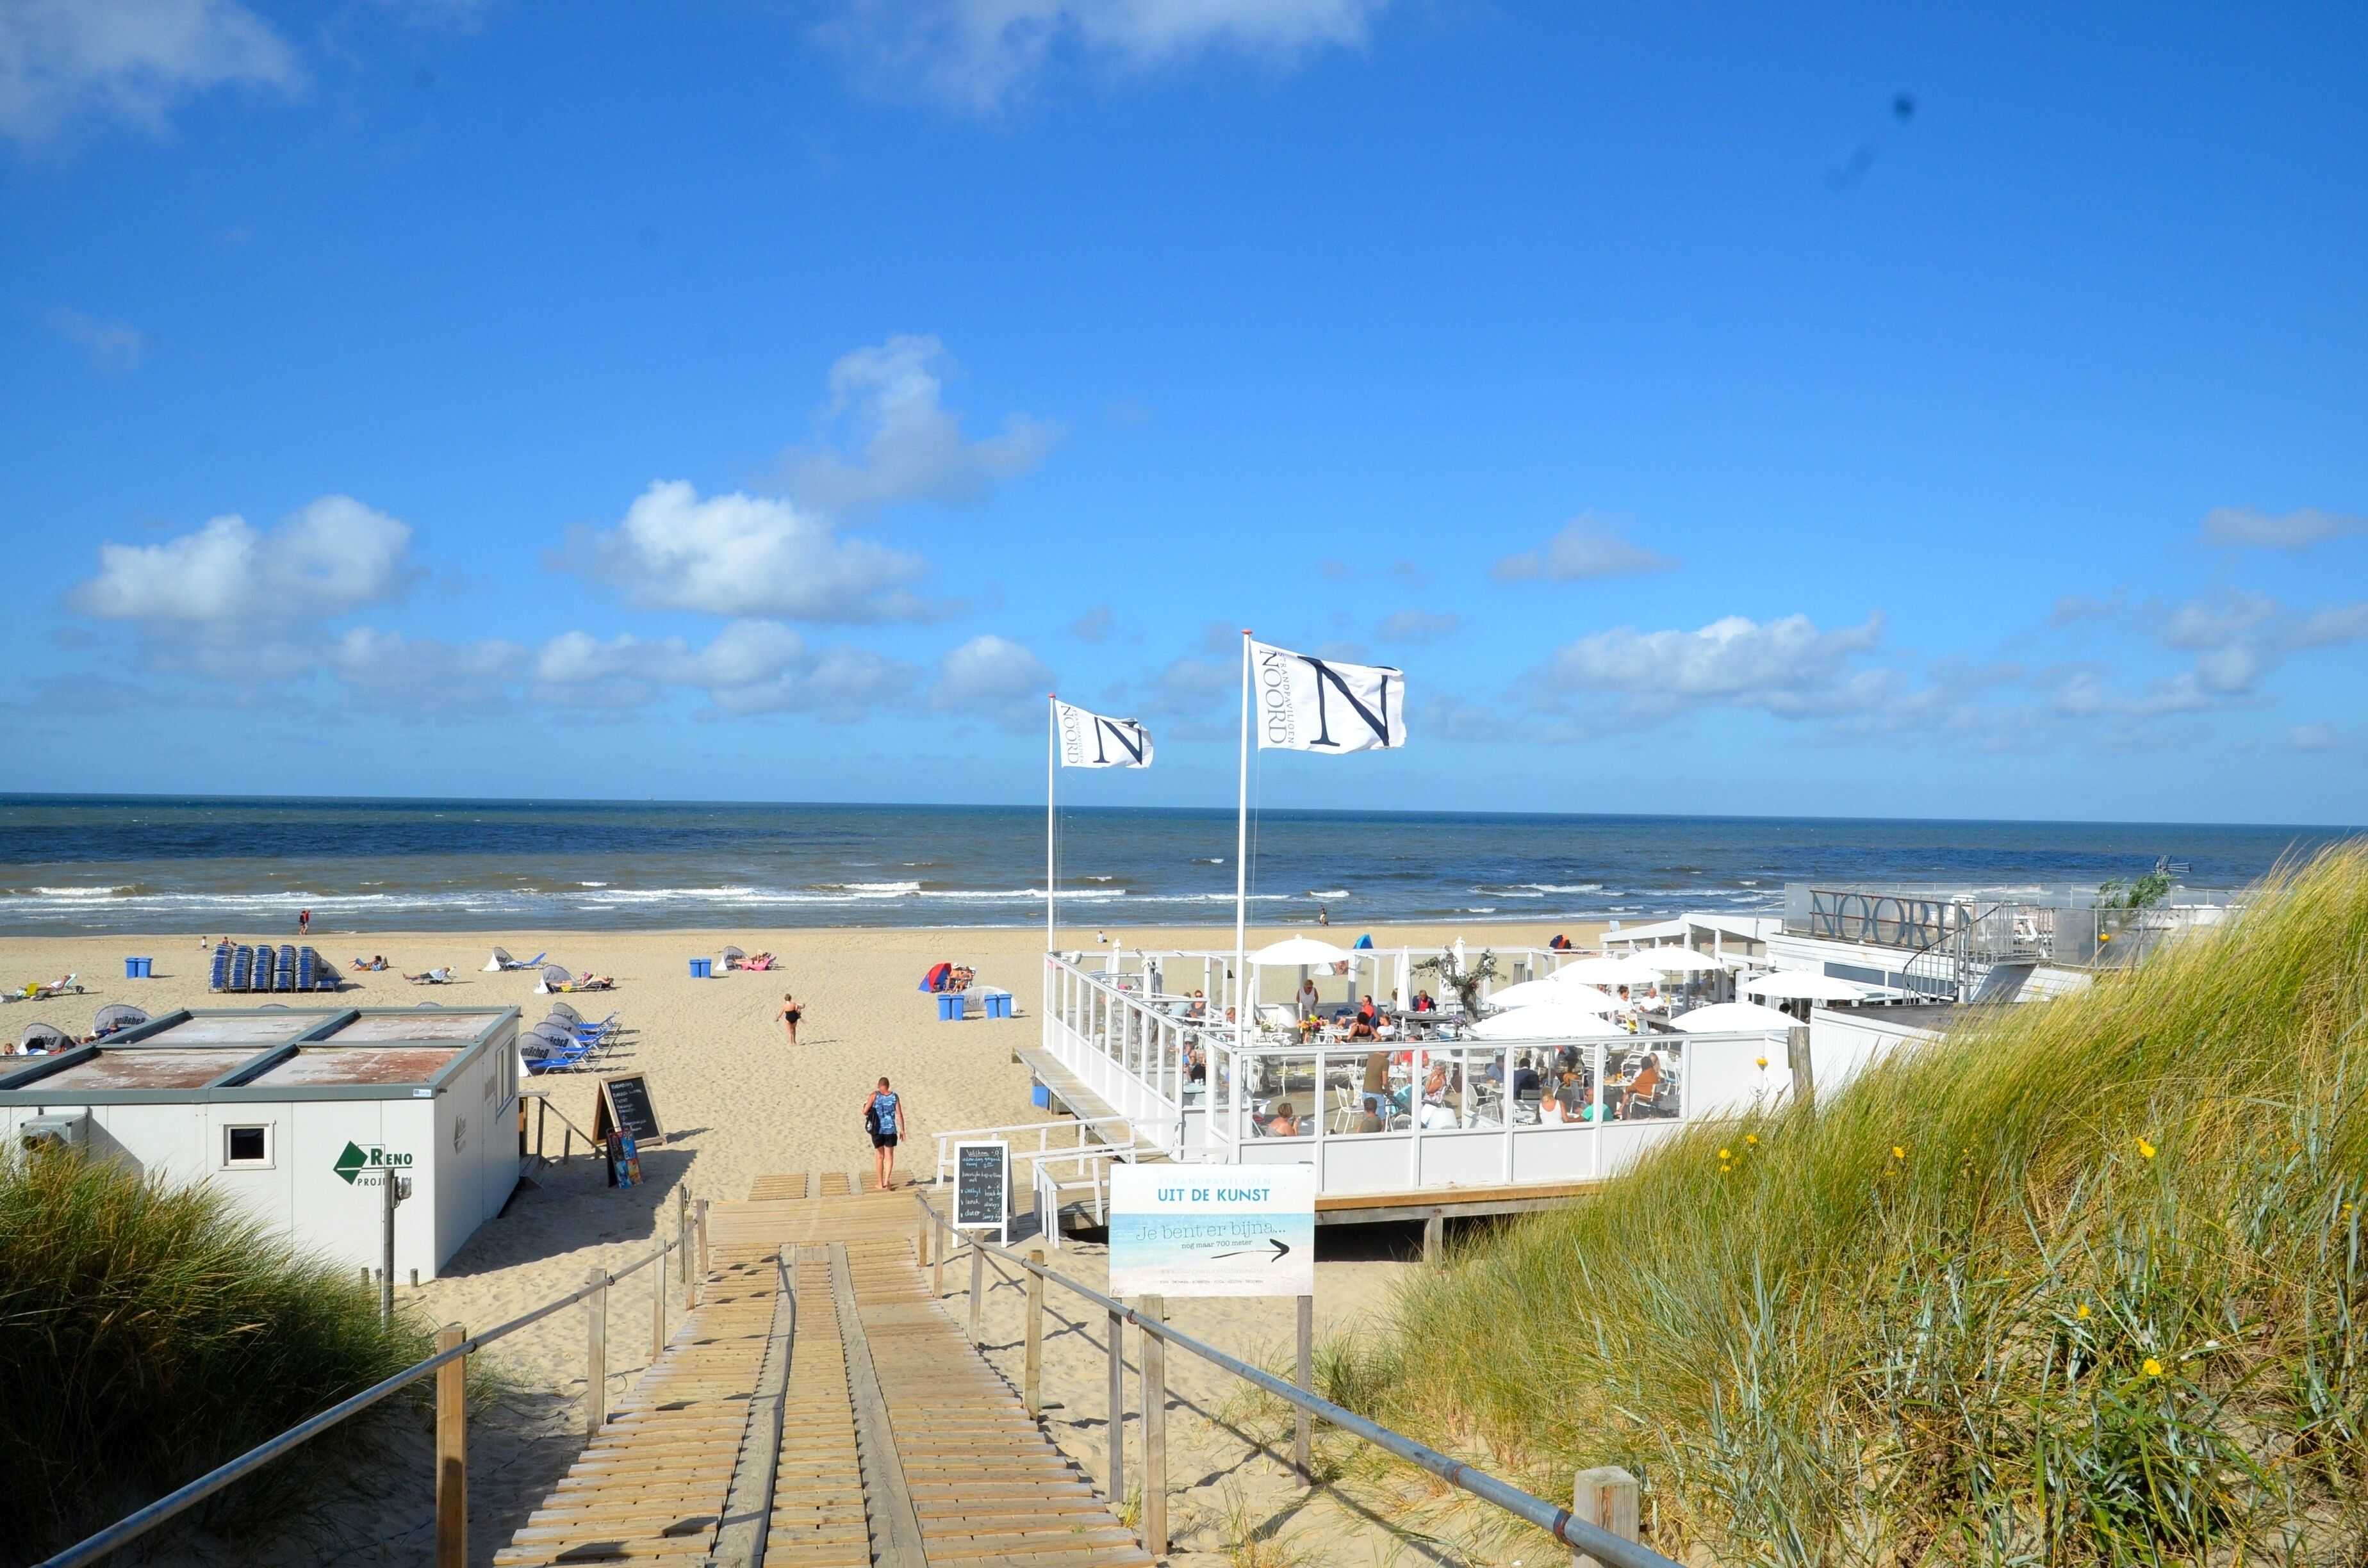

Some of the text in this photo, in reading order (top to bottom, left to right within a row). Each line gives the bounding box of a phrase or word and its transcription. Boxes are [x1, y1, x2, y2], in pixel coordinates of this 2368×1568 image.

[1259, 649, 1287, 744] NOORD
[1278, 652, 1295, 744] STRANDPAVILJOEN
[1060, 705, 1080, 764] NOORD
[1808, 891, 1971, 955] NOORD
[370, 1148, 413, 1166] RENO
[1158, 1188, 1270, 1202] UIT DE KUNST
[1135, 1226, 1158, 1241] Je
[1162, 1224, 1203, 1239] bent
[1207, 1227, 1226, 1237] er
